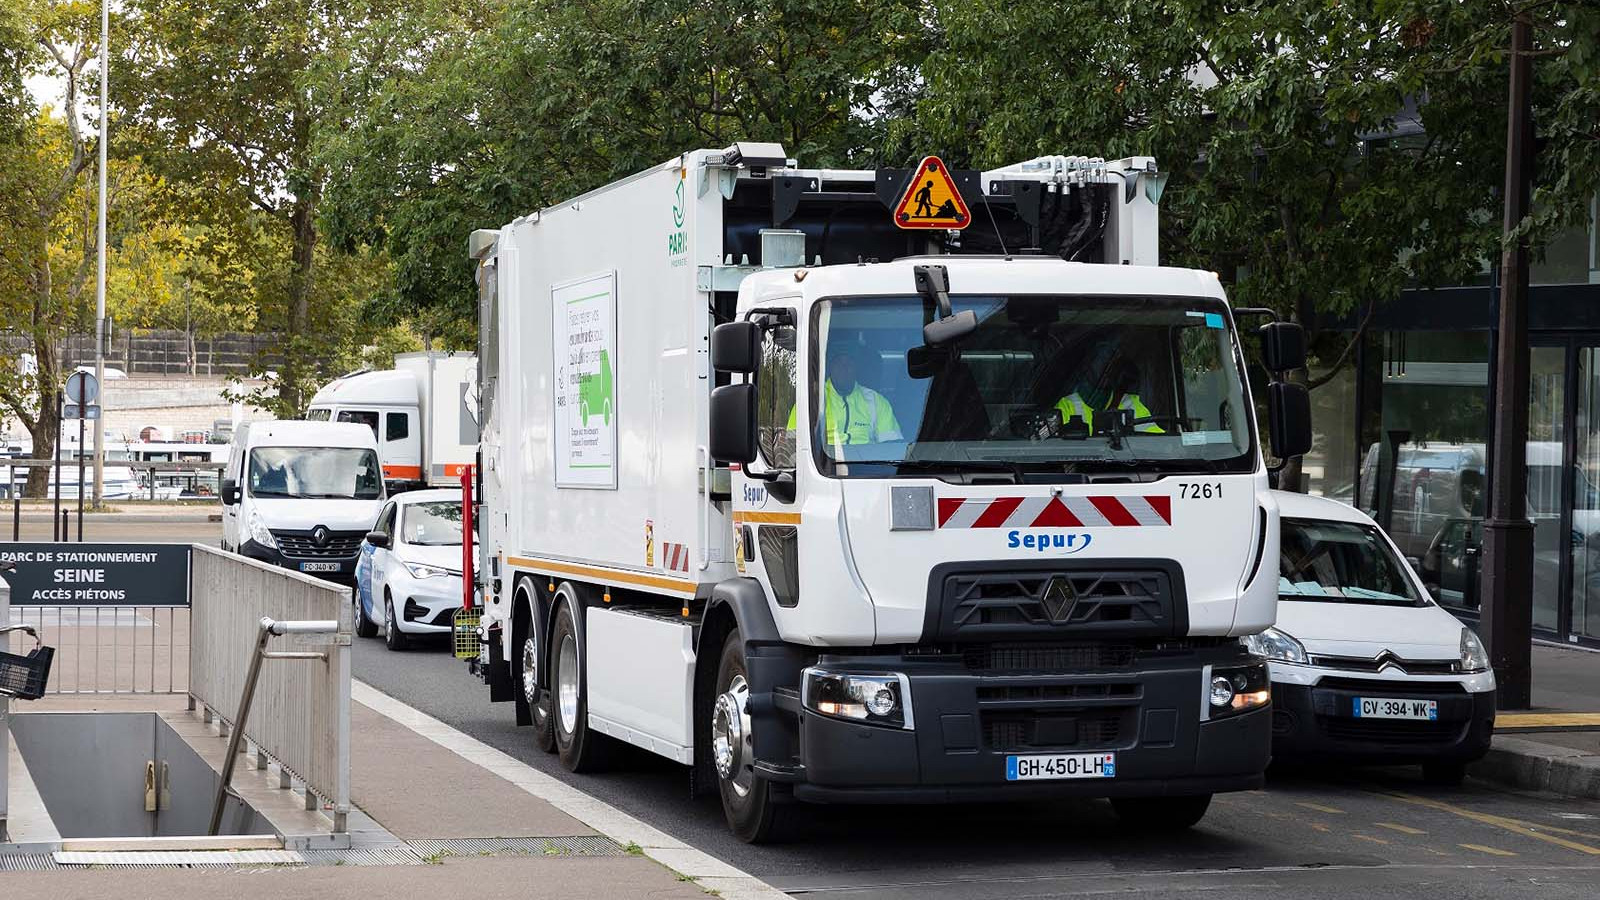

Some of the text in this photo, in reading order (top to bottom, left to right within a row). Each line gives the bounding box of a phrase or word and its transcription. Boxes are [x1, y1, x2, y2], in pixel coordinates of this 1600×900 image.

[744, 482, 765, 506] Sepur
[1178, 483, 1222, 499] 7261
[1008, 530, 1077, 552] Sepur
[1, 552, 158, 563] PARC DE STATIONNEMENT
[53, 569, 105, 583] SEINE
[32, 587, 126, 600] ACCÈS PIÉTONS
[1018, 757, 1104, 776] GH-450-LH
